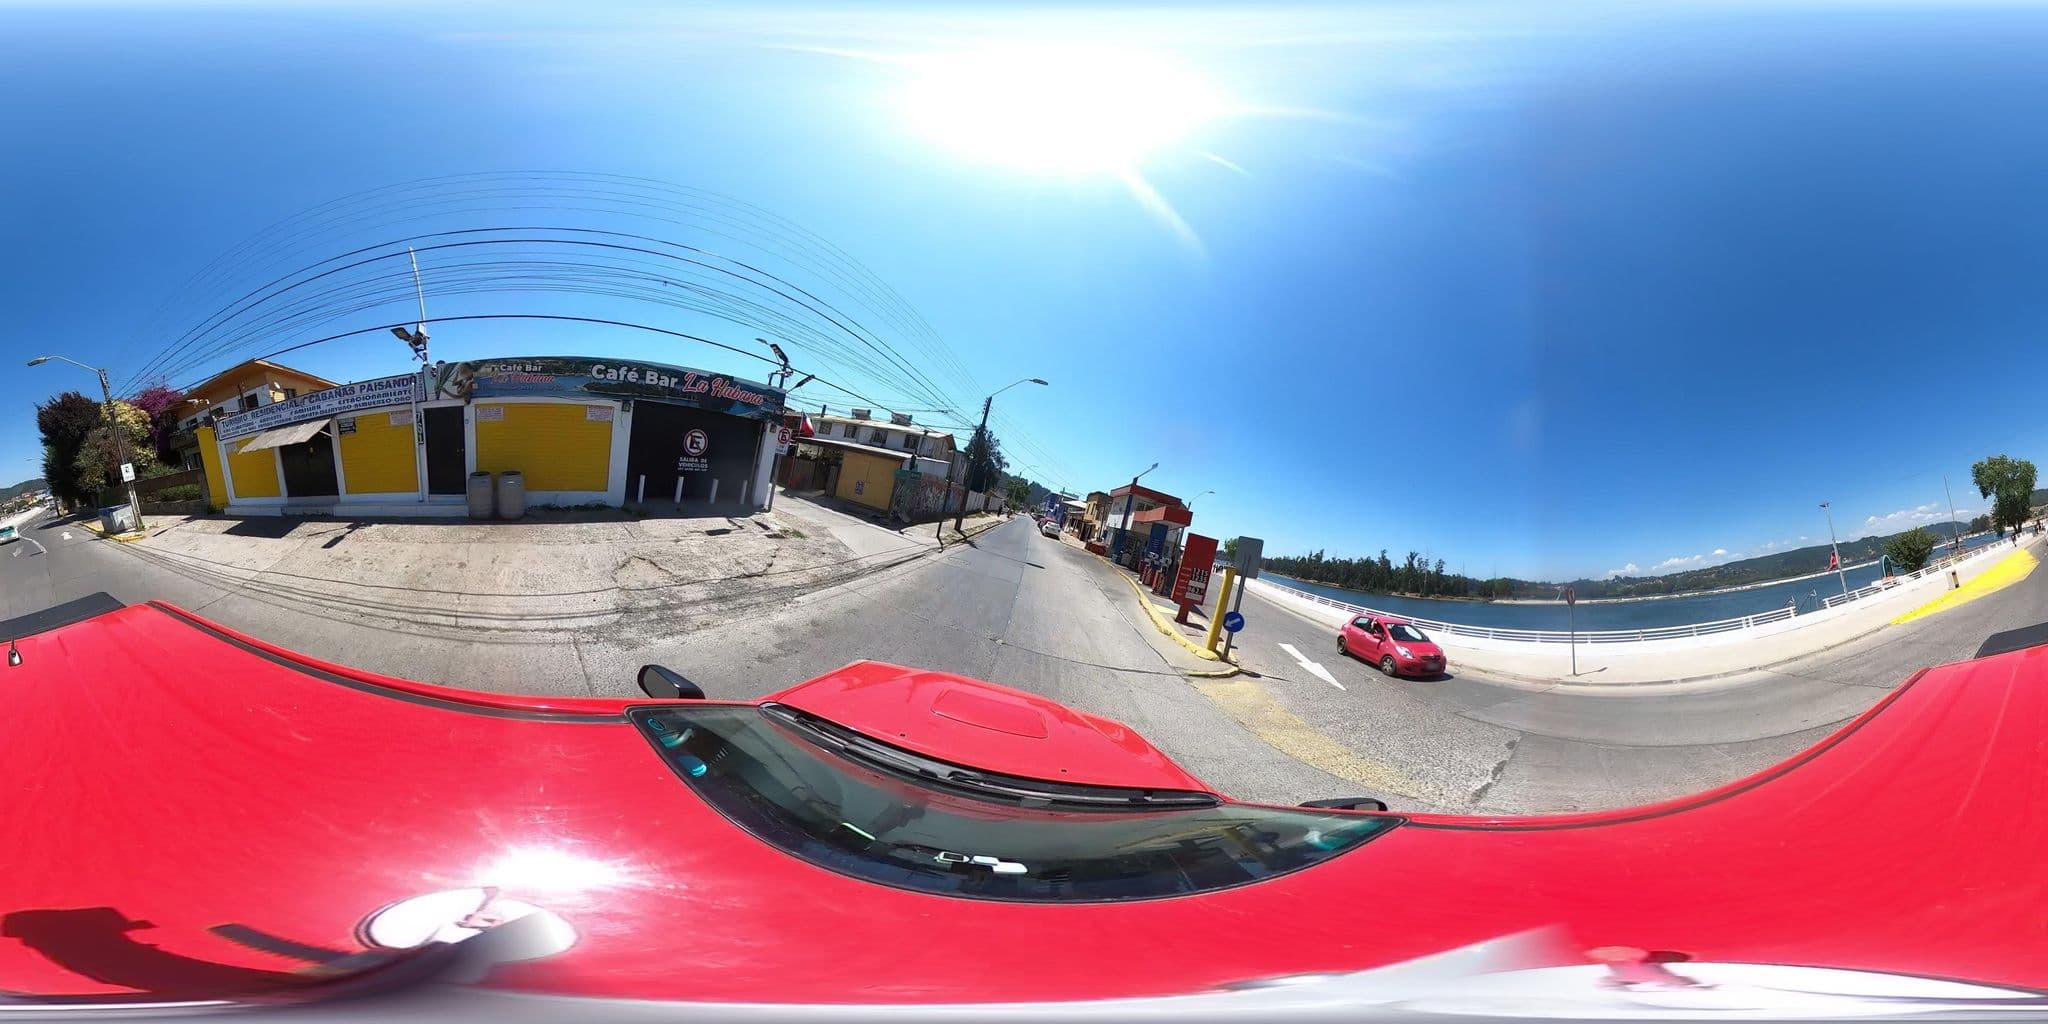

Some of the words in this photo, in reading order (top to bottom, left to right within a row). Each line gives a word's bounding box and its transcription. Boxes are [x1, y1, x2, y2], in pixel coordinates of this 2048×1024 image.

[500, 364, 522, 372] Café
[525, 364, 542, 372] Bar
[591, 364, 639, 383] Café
[645, 370, 678, 388] Bar
[682, 371, 709, 393] La
[711, 378, 764, 405] Habana
[251, 400, 299, 418] RESIDENCIAL
